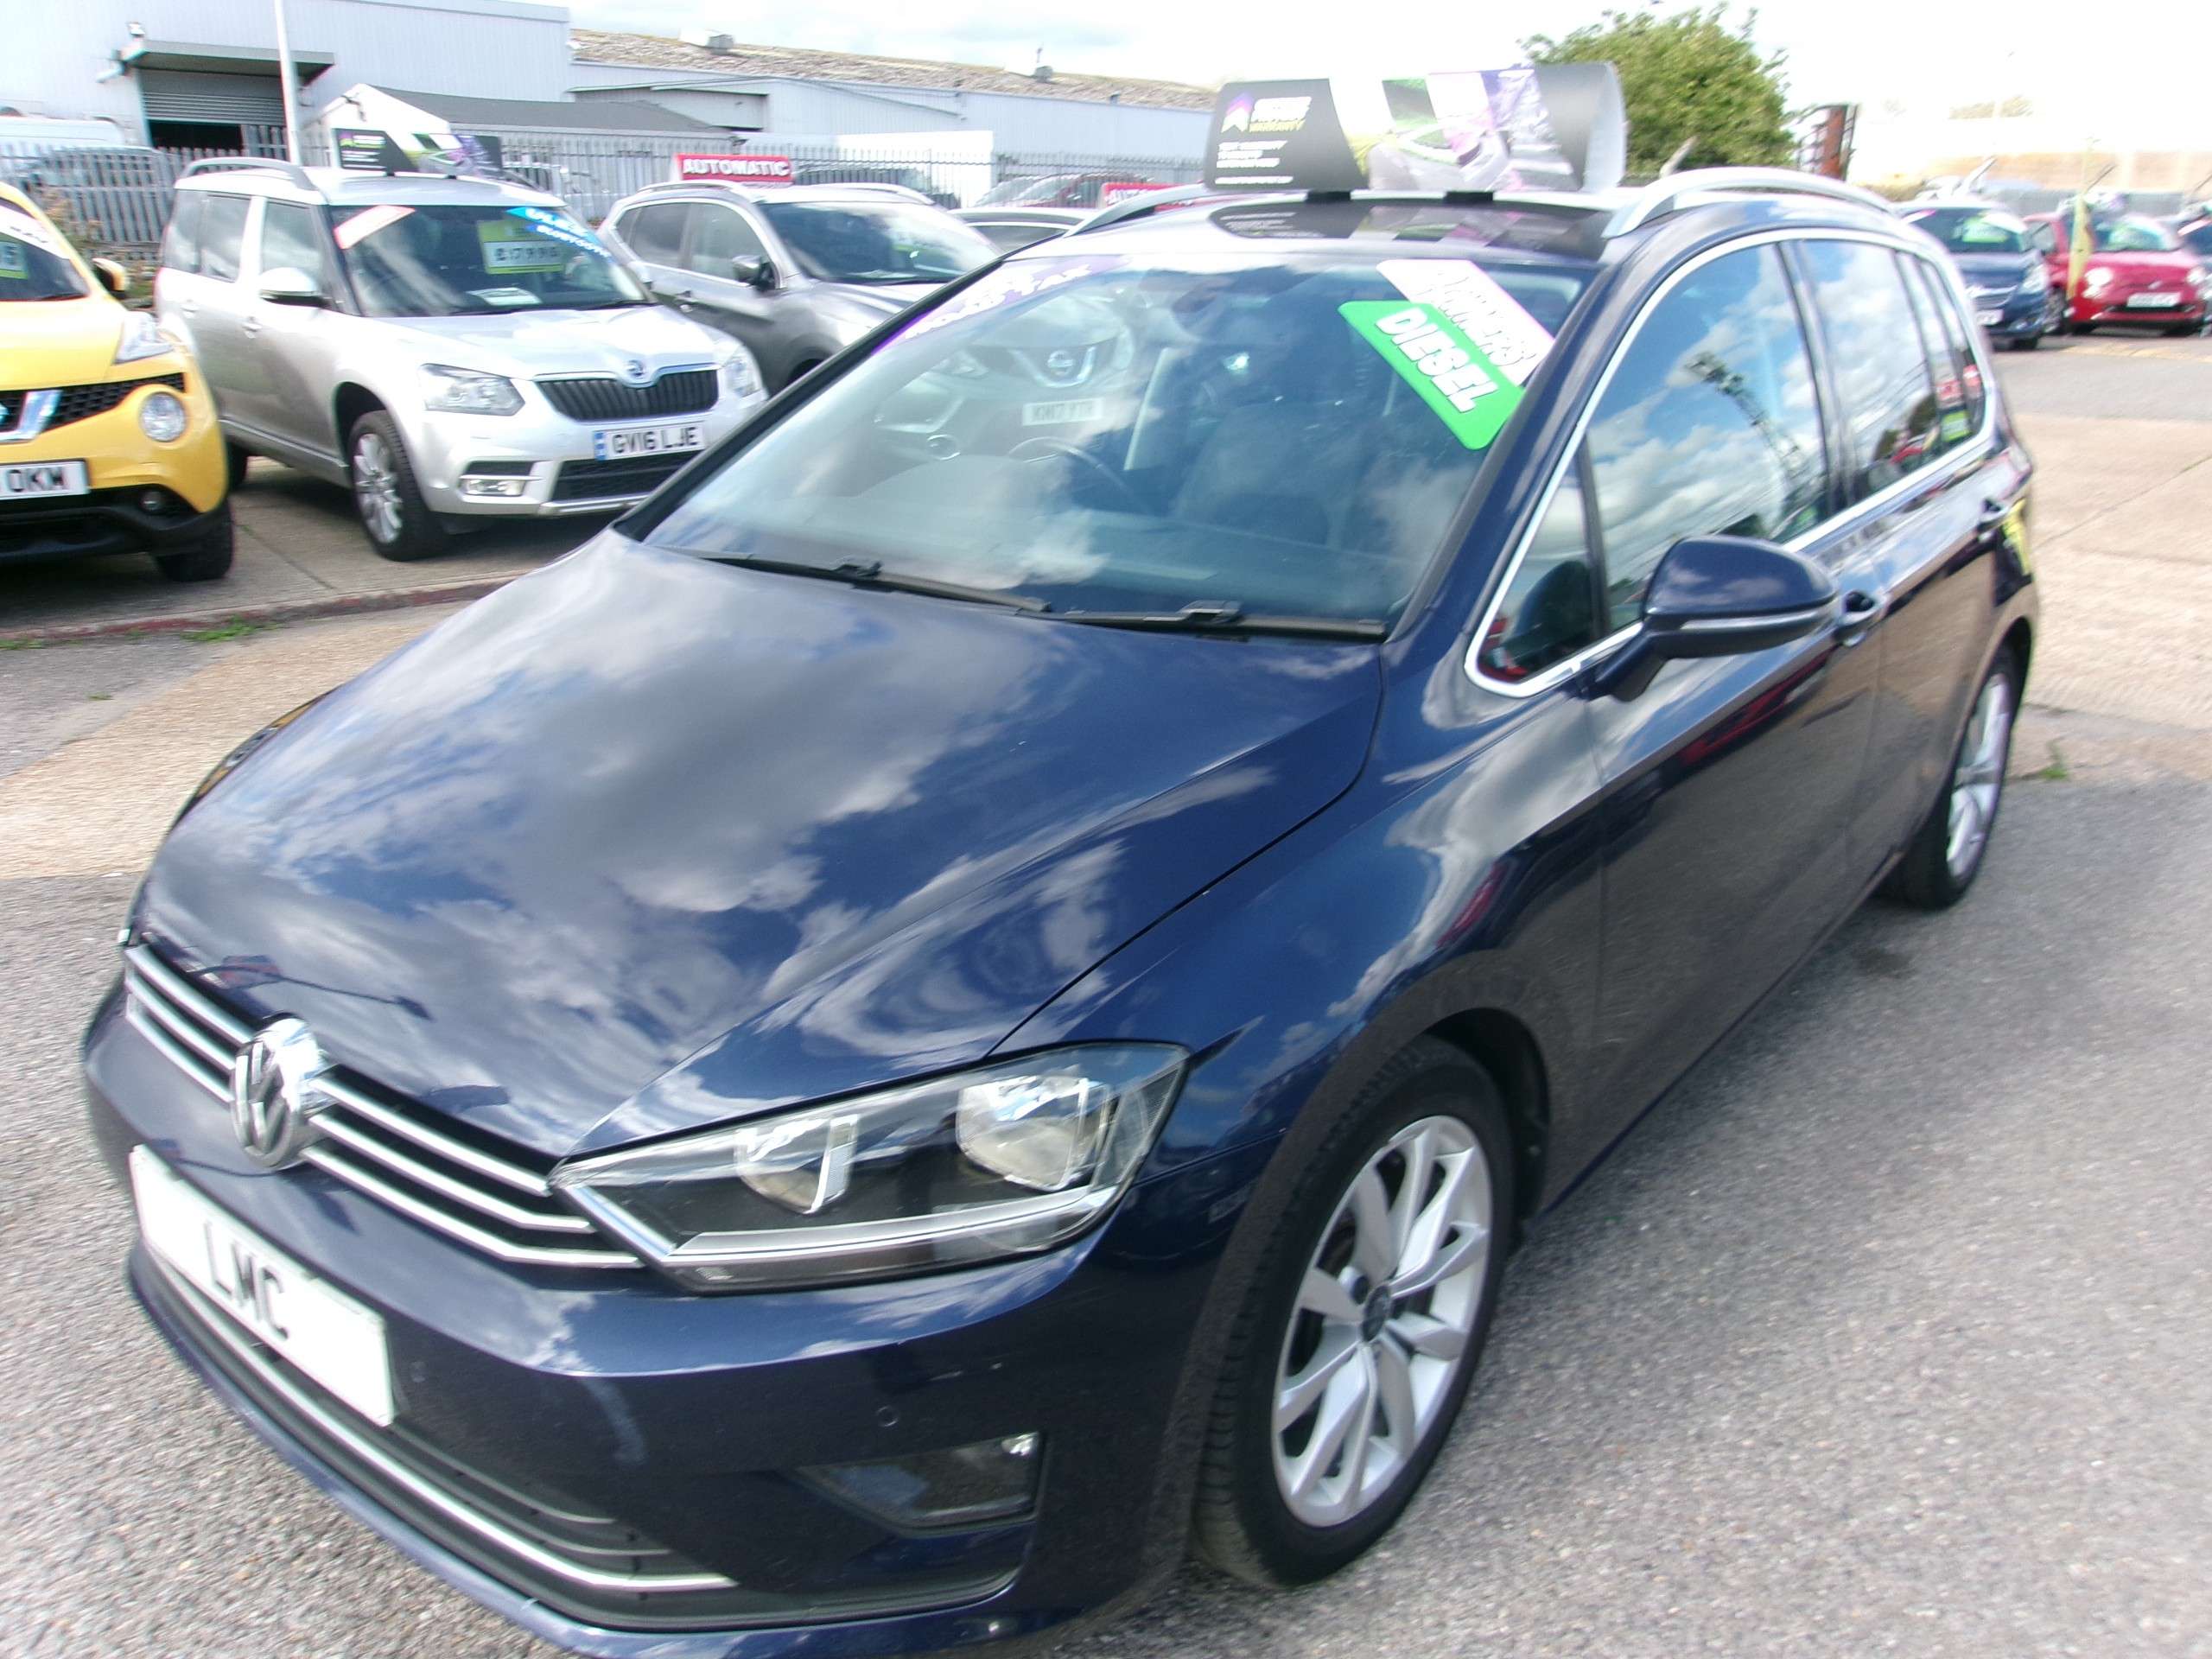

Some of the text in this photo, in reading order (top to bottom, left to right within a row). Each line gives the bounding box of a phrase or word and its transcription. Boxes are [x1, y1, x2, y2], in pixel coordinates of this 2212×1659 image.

[683, 159, 791, 176] AUTOMATIC
[1375, 306, 1499, 414] DIESEL
[612, 426, 698, 454] GV16 LJE
